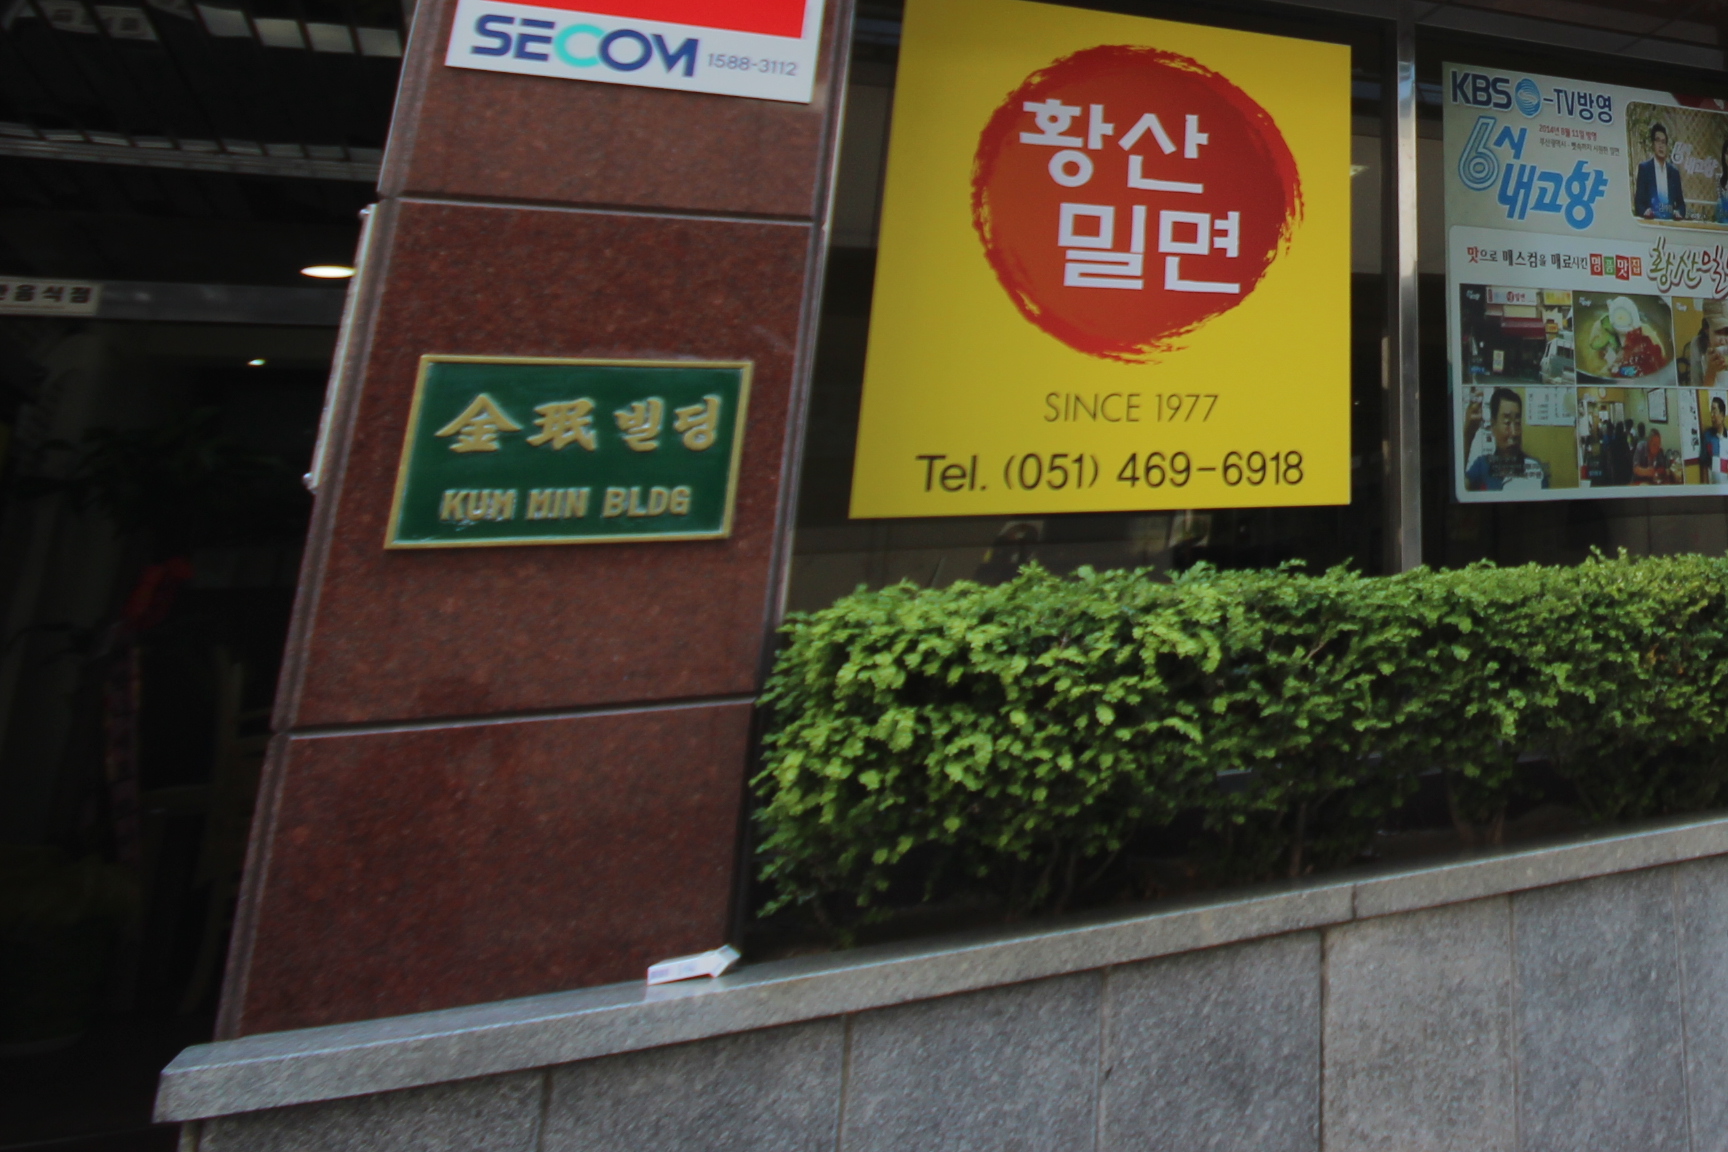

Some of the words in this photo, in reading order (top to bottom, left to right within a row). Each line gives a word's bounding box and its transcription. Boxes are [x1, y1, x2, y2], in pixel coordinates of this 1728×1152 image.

[470, 12, 701, 79] SECOM
[706, 52, 798, 77] 1588-3112
[1451, 70, 1512, 111] KBS
[1019, 97, 1210, 194] 황산
[1497, 159, 1609, 230] 내고향
[1057, 201, 1241, 295] 밀면
[1466, 246, 1498, 264] 맛으로
[1502, 249, 1547, 269] 매스컴을
[1043, 391, 1141, 424] SINCE
[1154, 393, 1219, 424] 1977
[915, 453, 988, 493] Tel.
[1003, 452, 1100, 490] (051)
[1116, 450, 1305, 489] 469-6918
[439, 487, 518, 522] KUM
[526, 486, 591, 521] MIN
[601, 485, 692, 519] BLDG
